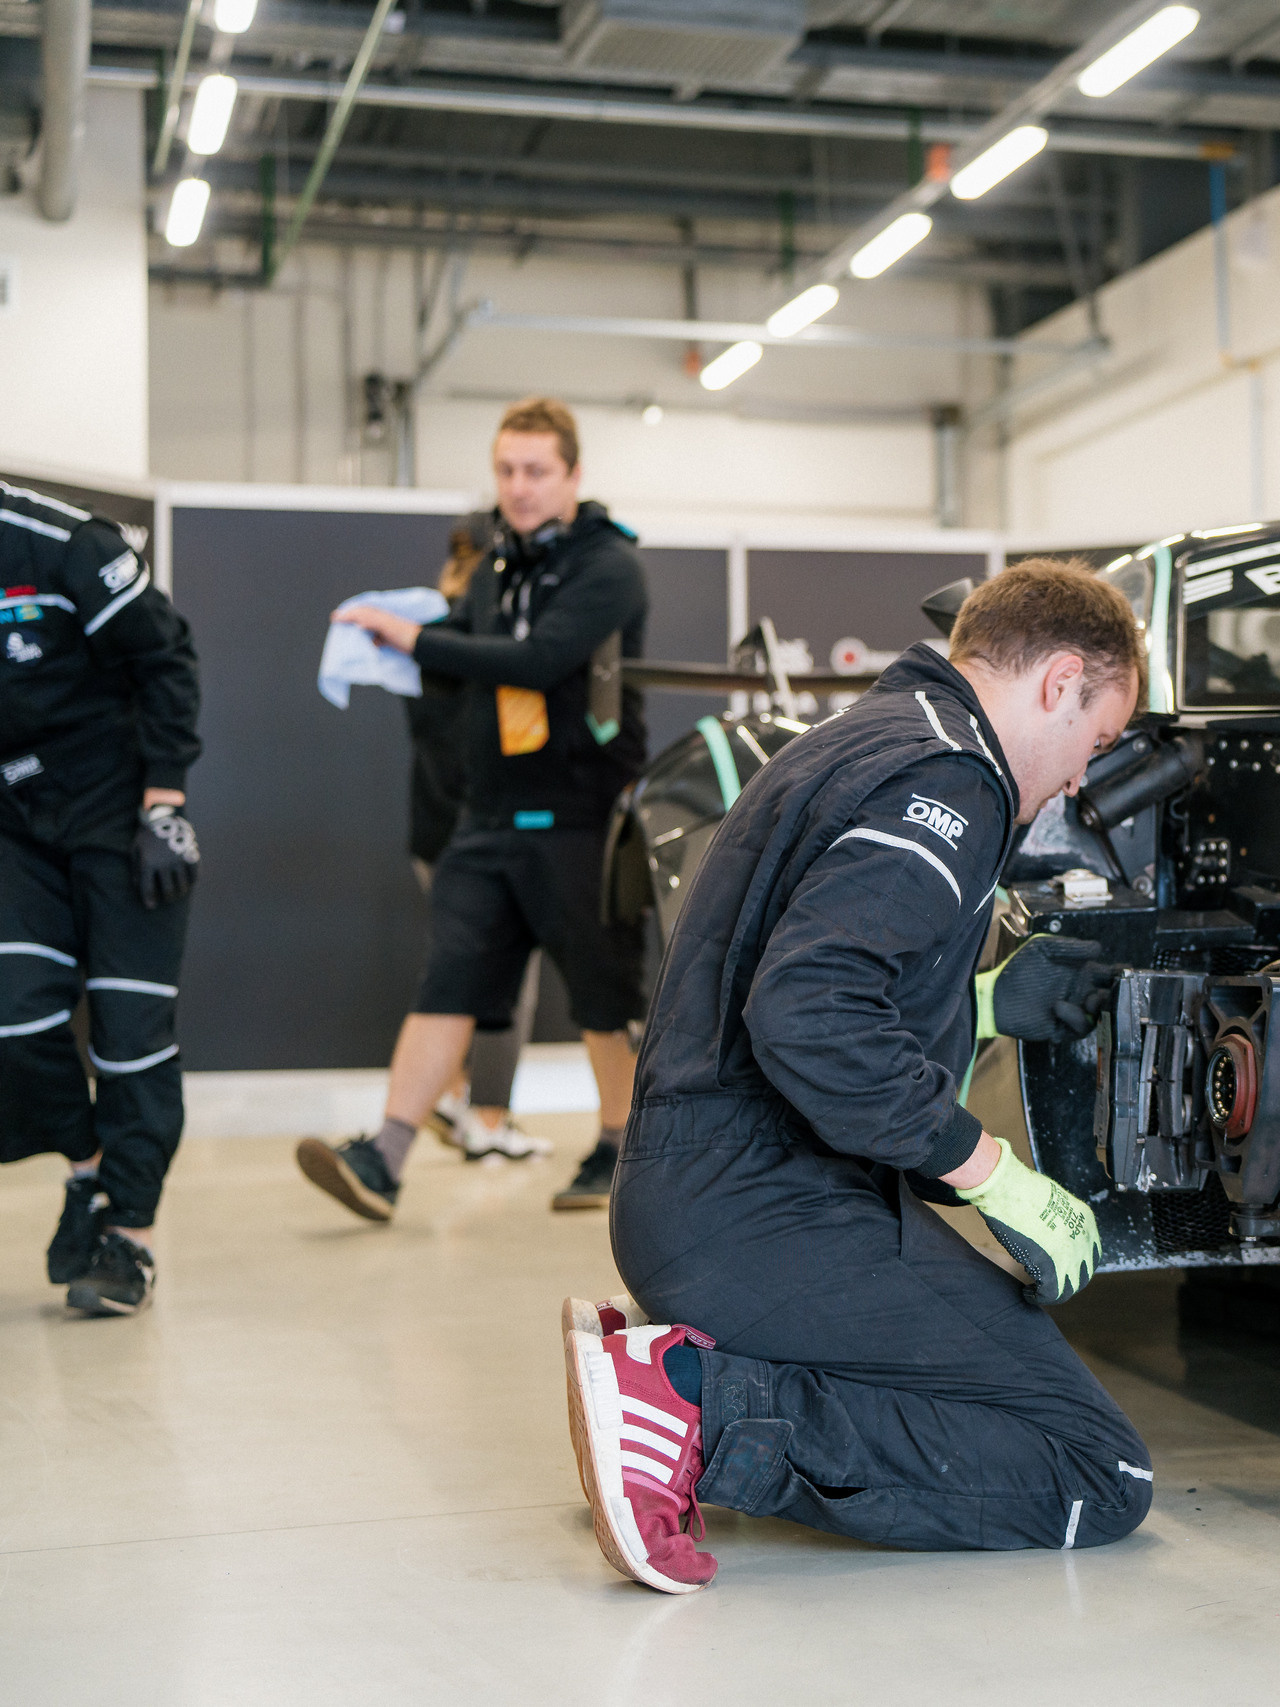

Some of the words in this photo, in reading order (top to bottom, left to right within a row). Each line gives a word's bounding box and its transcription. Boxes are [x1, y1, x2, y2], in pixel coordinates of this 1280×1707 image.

[907, 802, 964, 839] OMP
[1068, 1212, 1078, 1229] 710
[1069, 1212, 1086, 1240] MAPA
